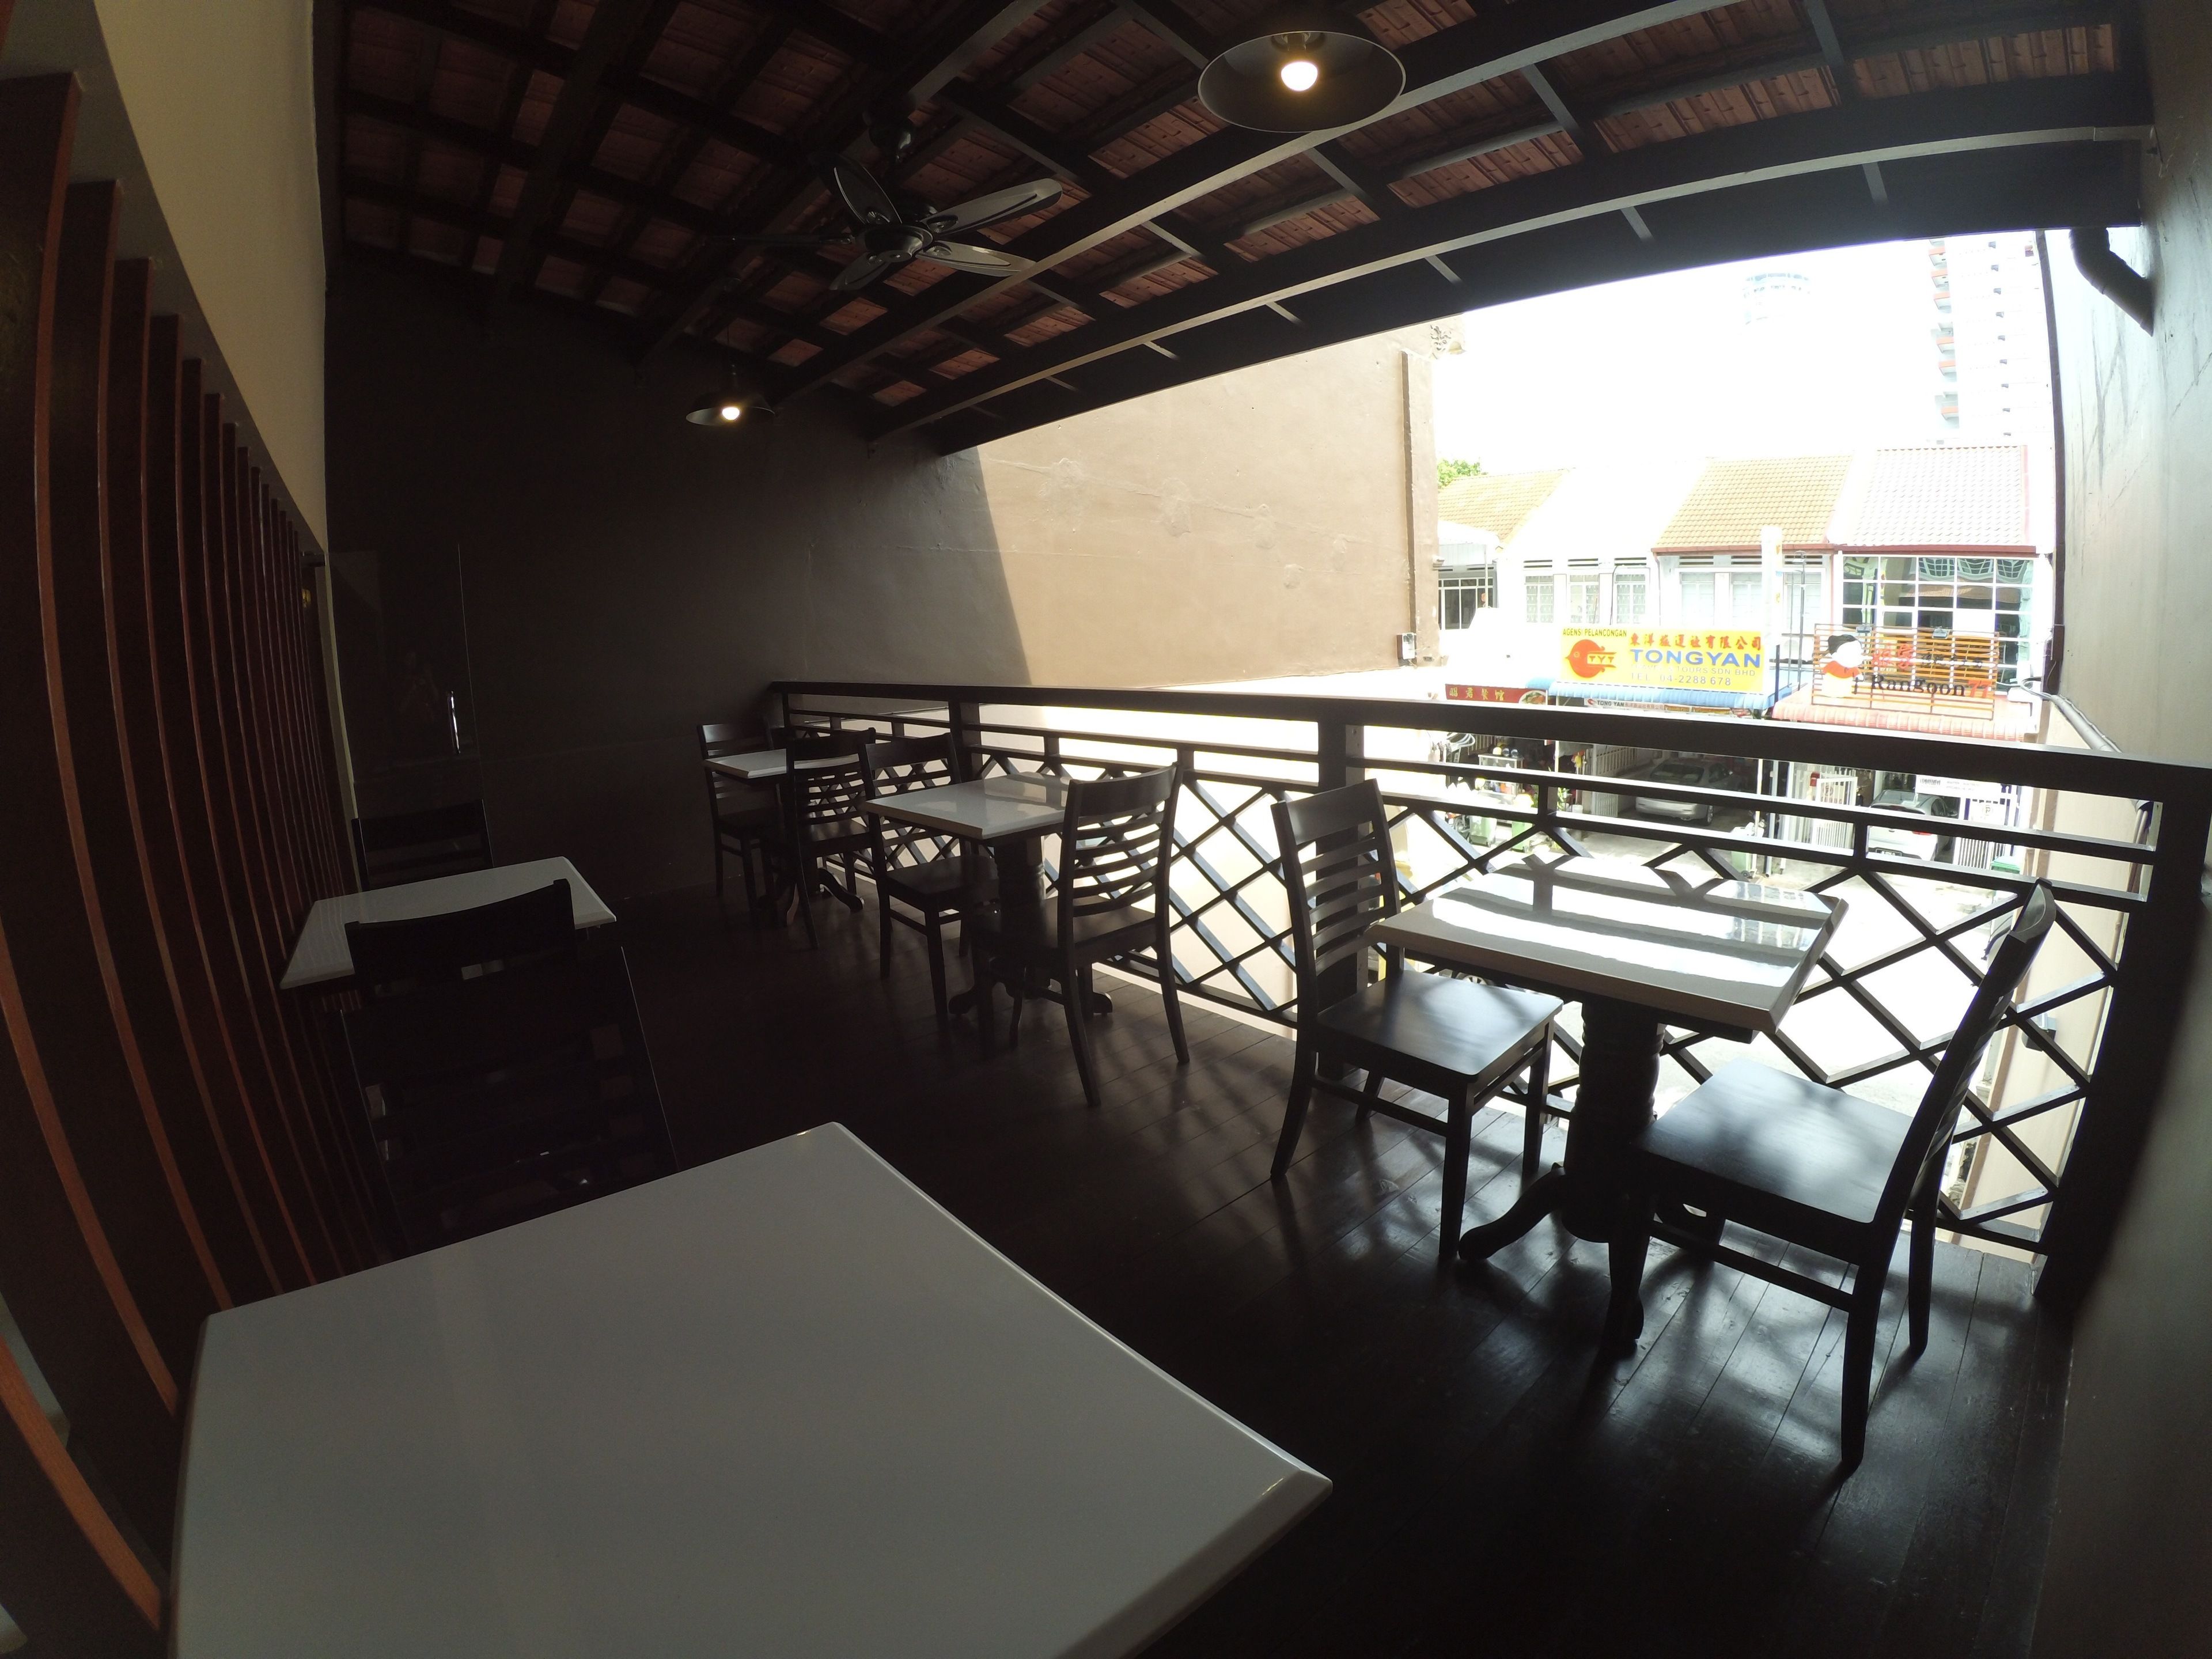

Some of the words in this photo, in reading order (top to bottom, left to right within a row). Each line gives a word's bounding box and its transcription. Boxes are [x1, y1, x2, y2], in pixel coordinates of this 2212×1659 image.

[1562, 628, 1583, 637] AGENSI
[1584, 628, 1627, 637] PELANCONGAN
[1630, 649, 1761, 668] TONGYAN
[1677, 666, 1709, 674] TOURS
[1872, 674, 1965, 697] Rangoon
[1968, 679, 1992, 699] 77
